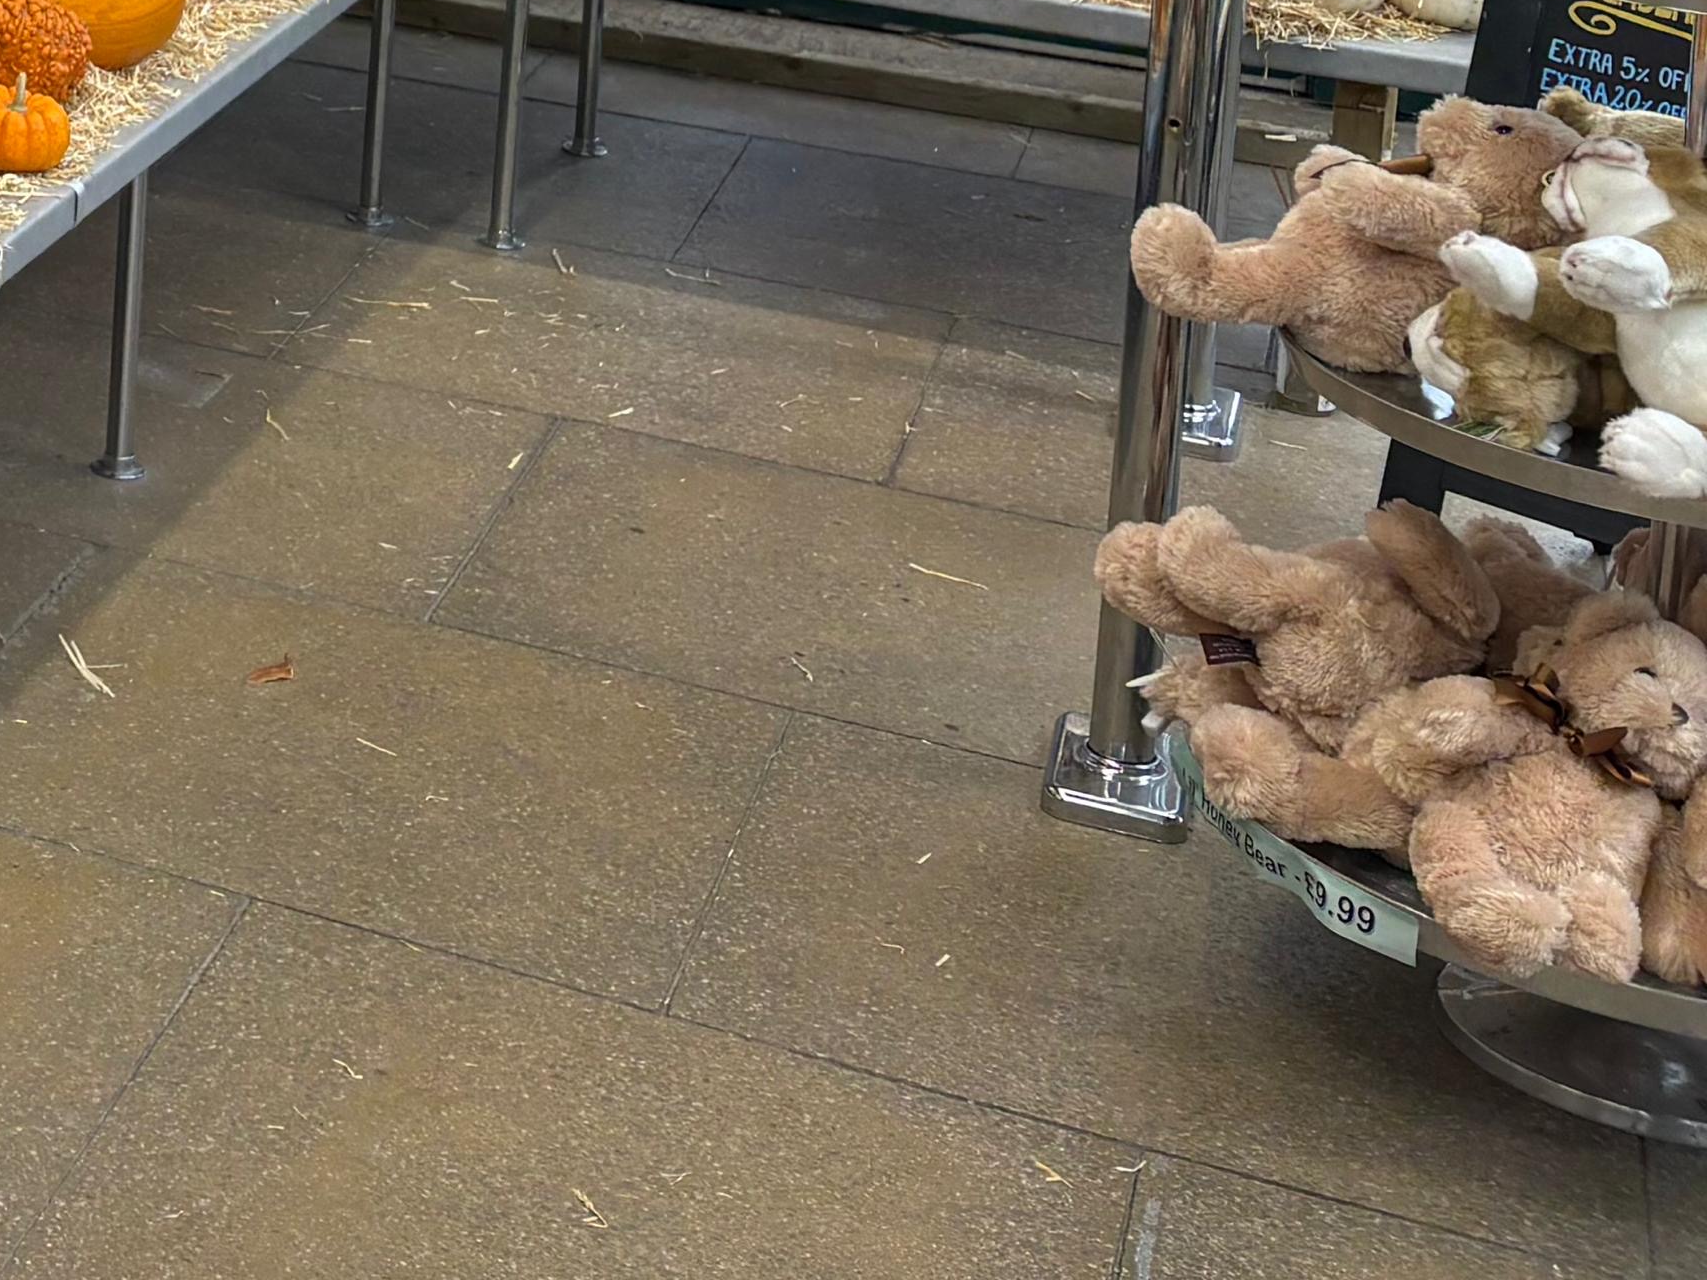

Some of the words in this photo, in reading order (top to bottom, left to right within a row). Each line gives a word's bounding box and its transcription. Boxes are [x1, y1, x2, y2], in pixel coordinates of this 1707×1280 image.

[1548, 38, 1613, 75] EXTRA
[1620, 56, 1650, 82] 5%
[1610, 85, 1653, 111] 20%
[1244, 833, 1286, 878] Bear
